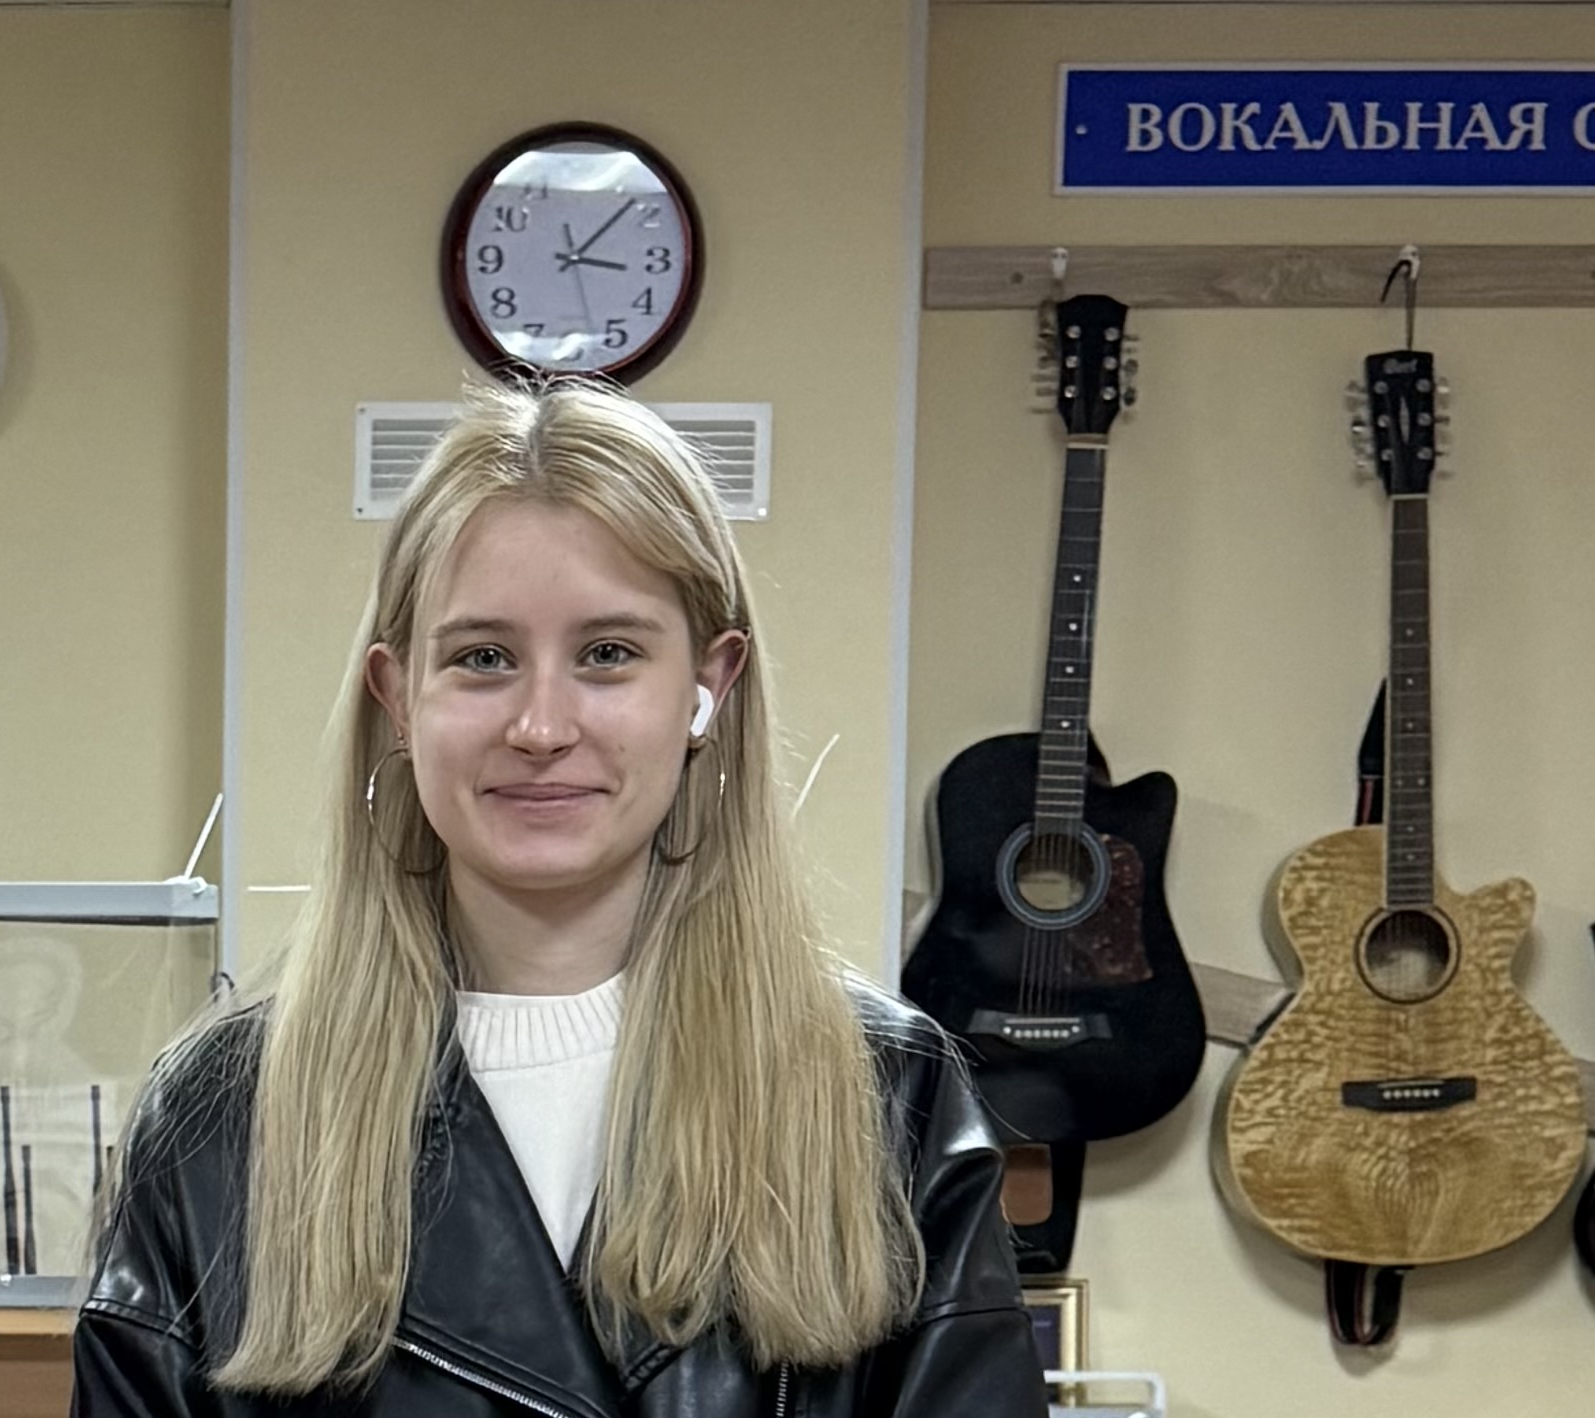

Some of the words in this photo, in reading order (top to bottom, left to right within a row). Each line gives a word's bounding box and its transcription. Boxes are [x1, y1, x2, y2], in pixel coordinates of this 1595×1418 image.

[1125, 101, 1549, 152] ВОКАЛЬНАЯ
[493, 205, 529, 233] 10
[477, 244, 504, 275] 9
[645, 246, 672, 275] 3
[490, 287, 518, 319] 8
[631, 286, 655, 317] 4
[603, 318, 629, 349] 5
